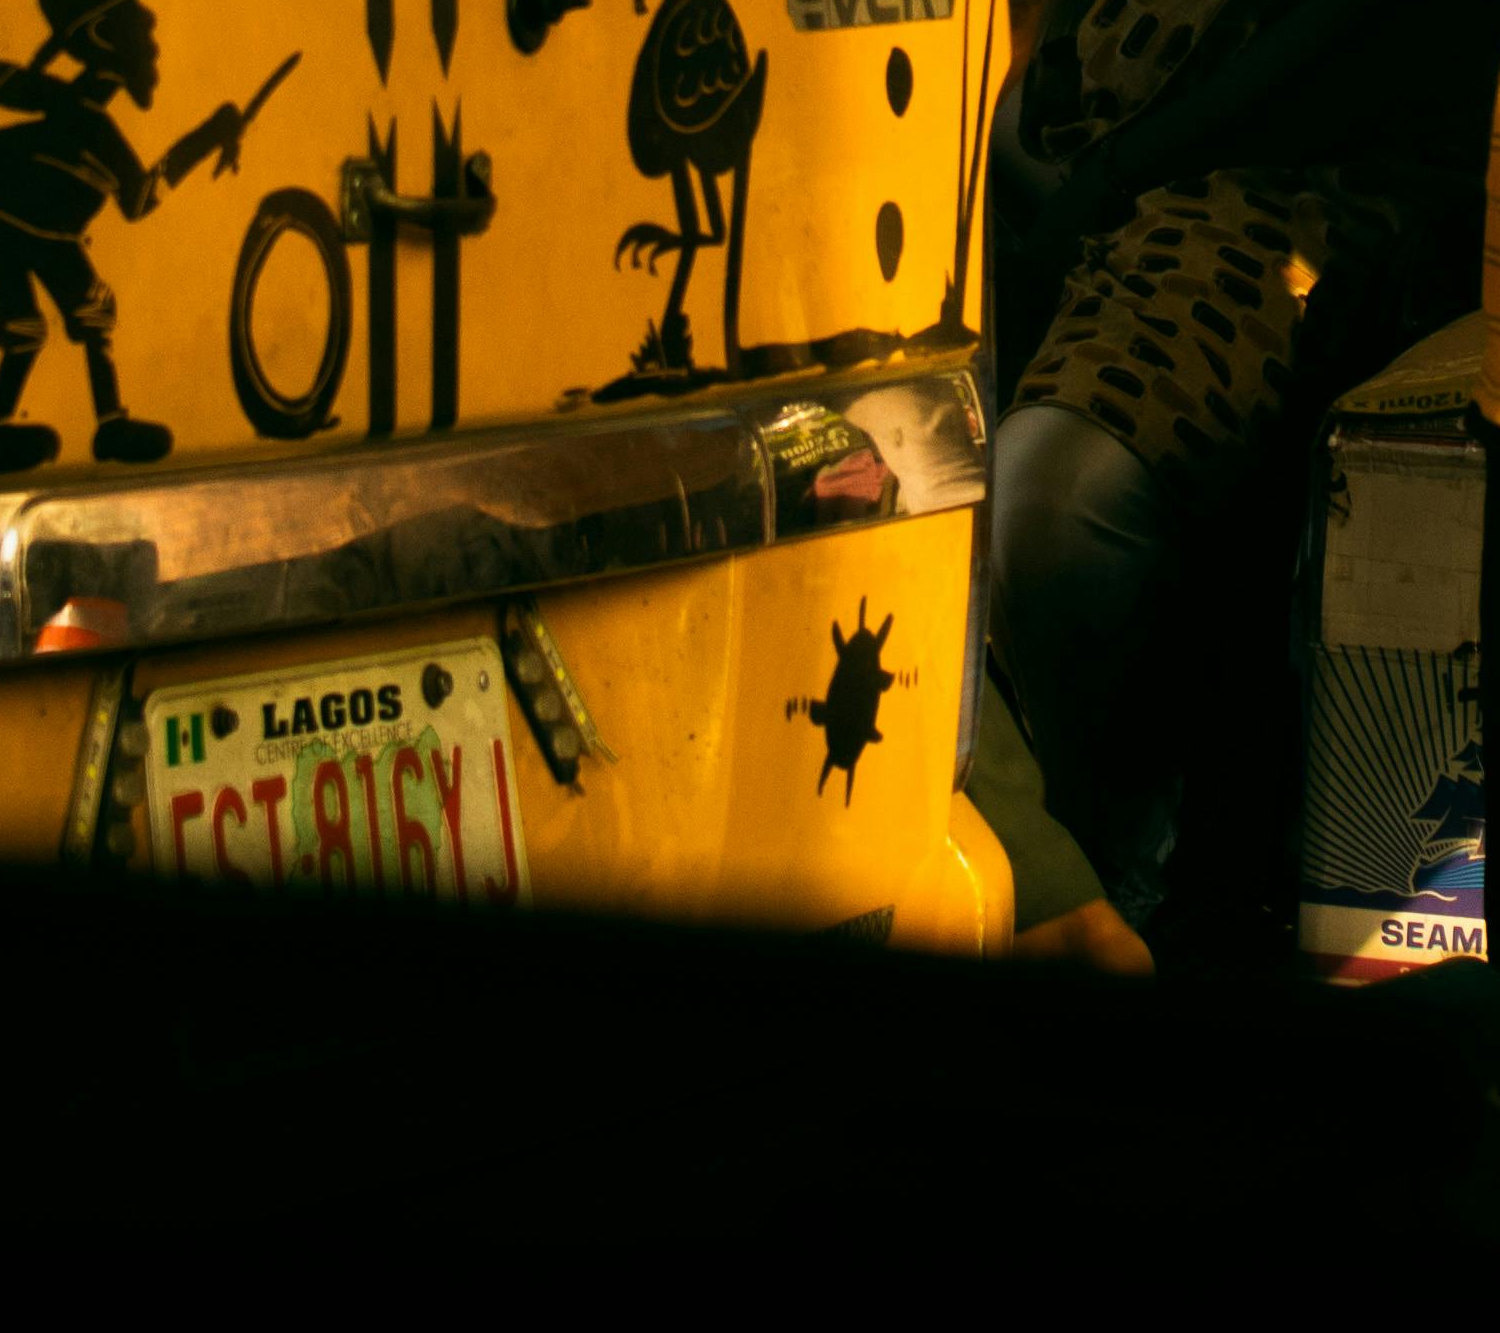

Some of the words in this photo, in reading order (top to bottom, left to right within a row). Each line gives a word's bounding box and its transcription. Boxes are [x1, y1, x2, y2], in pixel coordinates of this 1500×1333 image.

[261, 684, 404, 740] LAGOS
[334, 723, 414, 755] EXCELLENCE
[1380, 917, 1484, 956] SEAM
